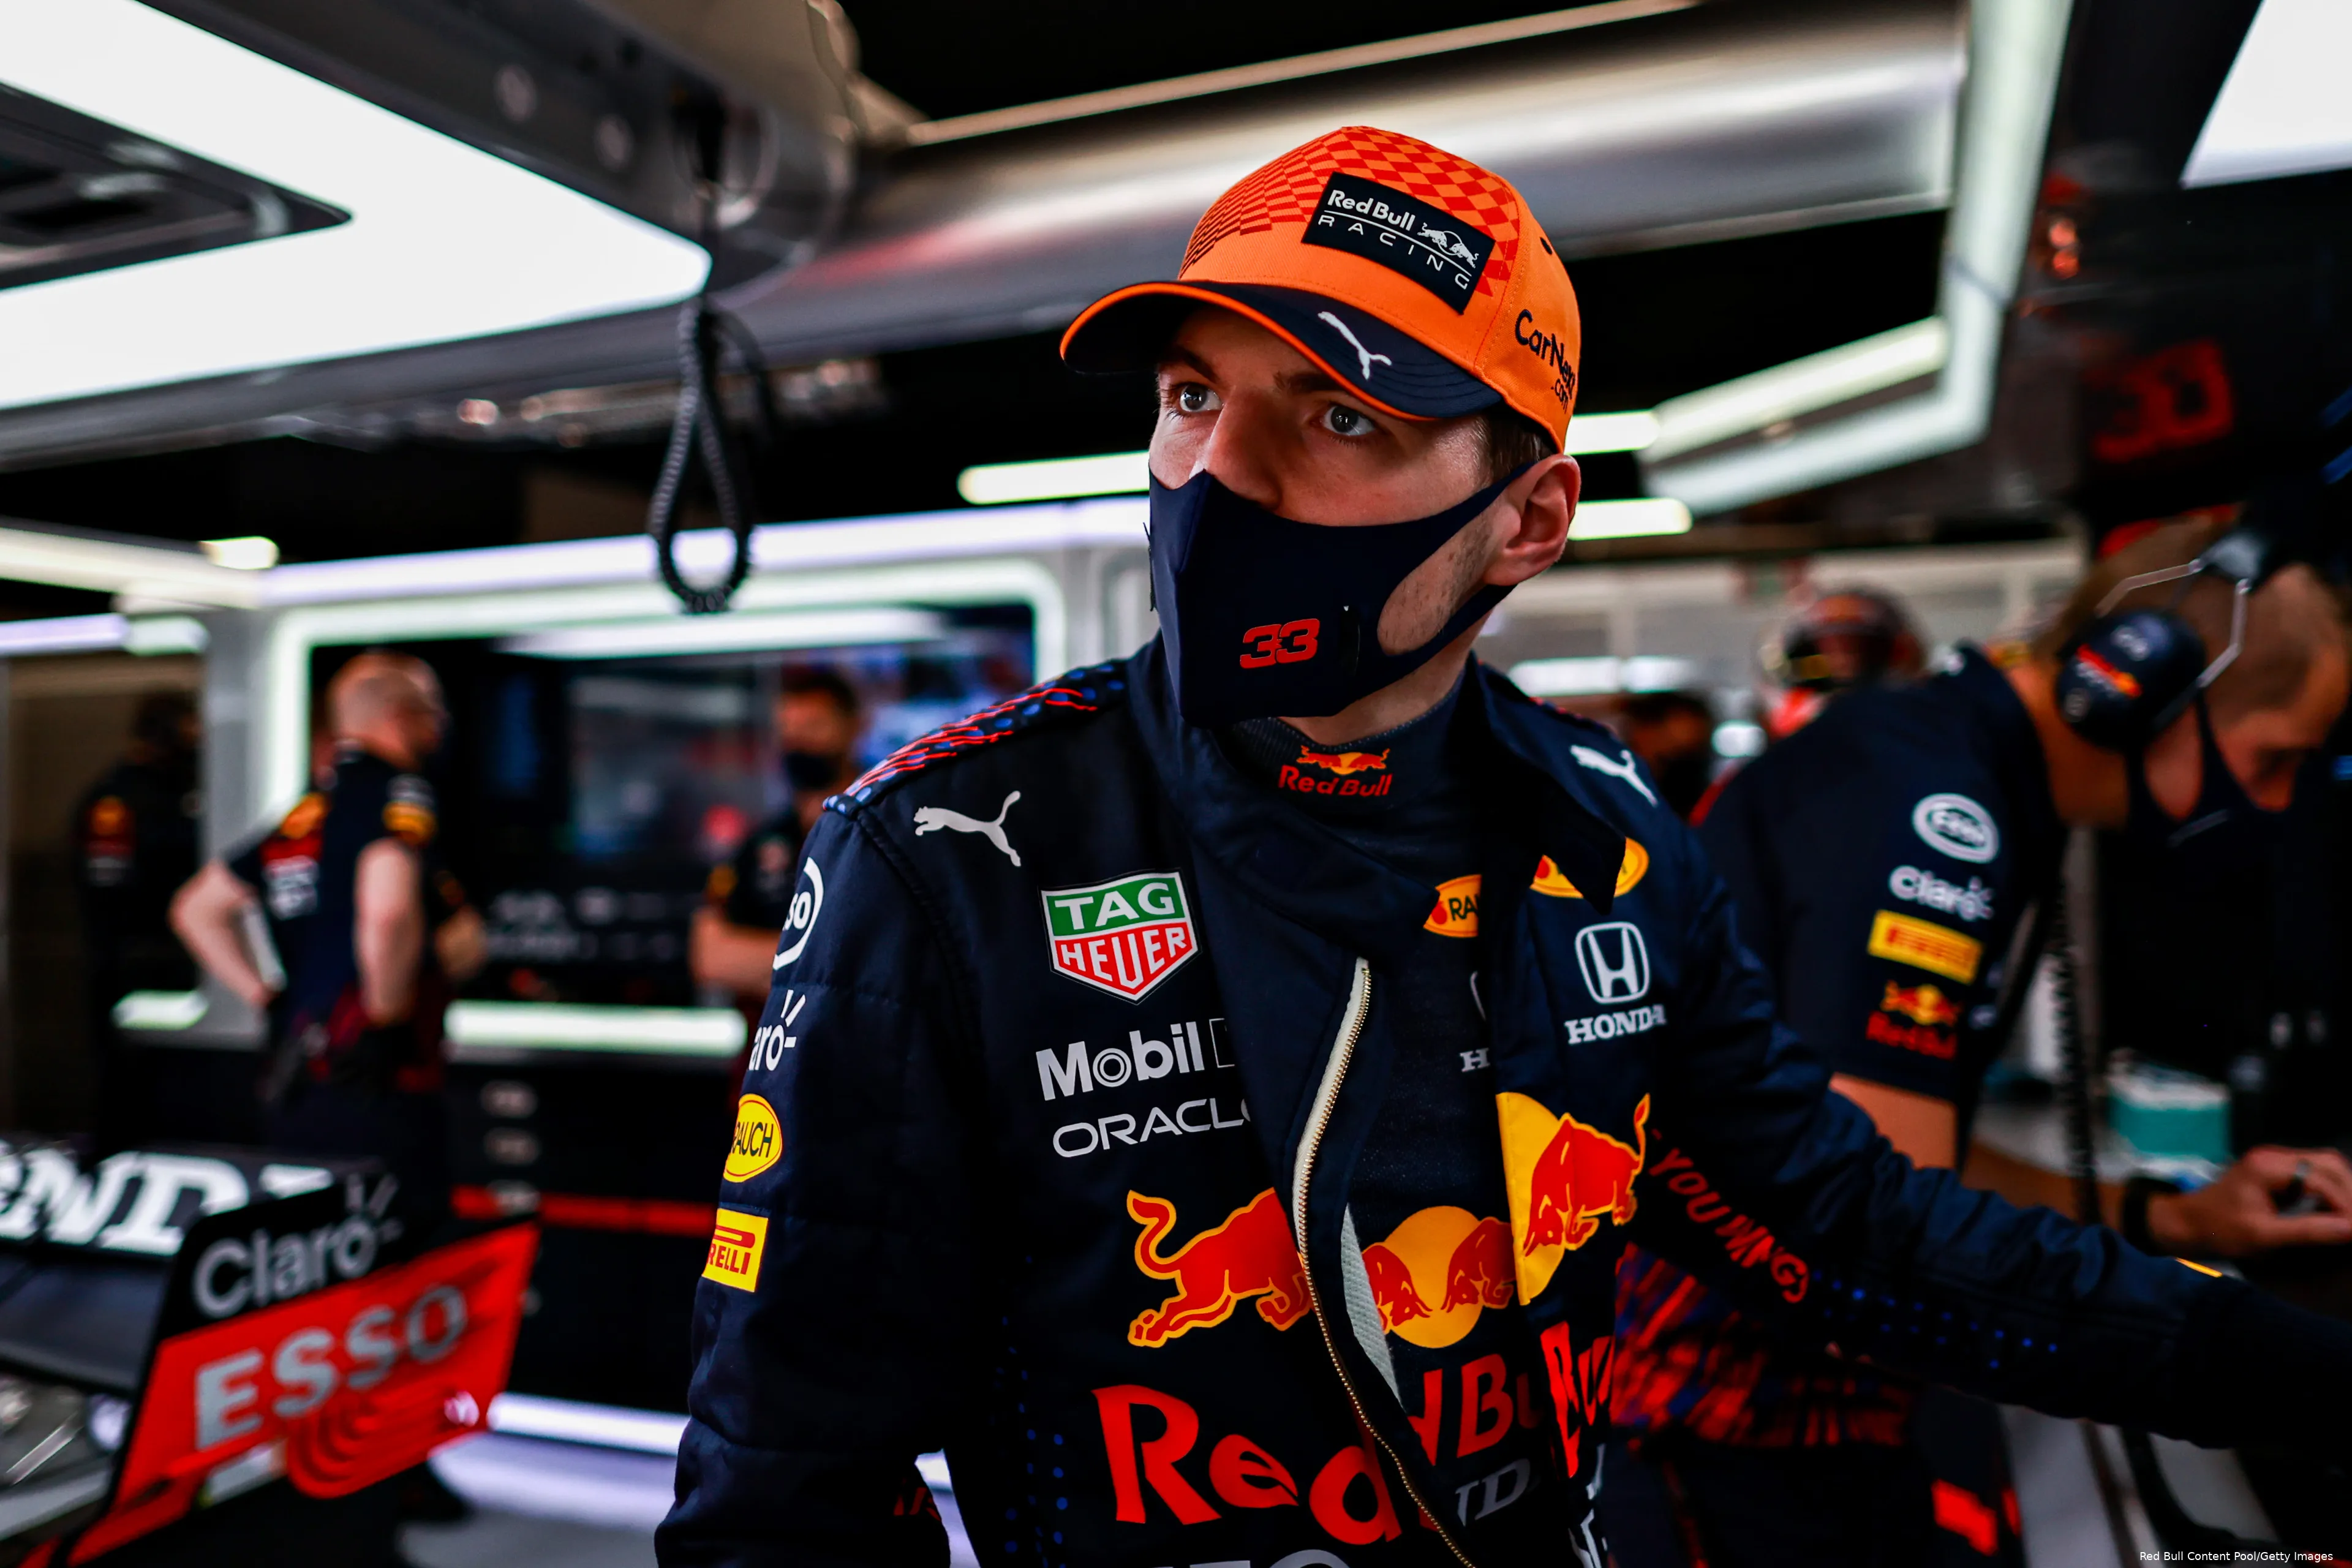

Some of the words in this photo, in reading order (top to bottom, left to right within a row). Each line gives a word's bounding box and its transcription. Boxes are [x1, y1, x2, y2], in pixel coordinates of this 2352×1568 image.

[1327, 189, 1374, 214] Red
[1372, 202, 1415, 231] Bull
[1318, 214, 1471, 290] RACING
[1240, 618, 1321, 669] 33
[1278, 764, 1340, 794] Red
[1338, 773, 1393, 797] Bull
[1054, 882, 1175, 930] TAG
[1060, 927, 1187, 989] HEUER
[748, 1025, 785, 1071] aro
[1564, 1005, 1668, 1044] HONDA
[1036, 1021, 1205, 1101] Mobil
[1053, 1098, 1251, 1158] ORACL
[1648, 1147, 1732, 1223] YOU
[193, 1214, 377, 1317] Claro
[194, 1284, 467, 1451] ESSO
[1091, 1384, 1403, 1545] Red
